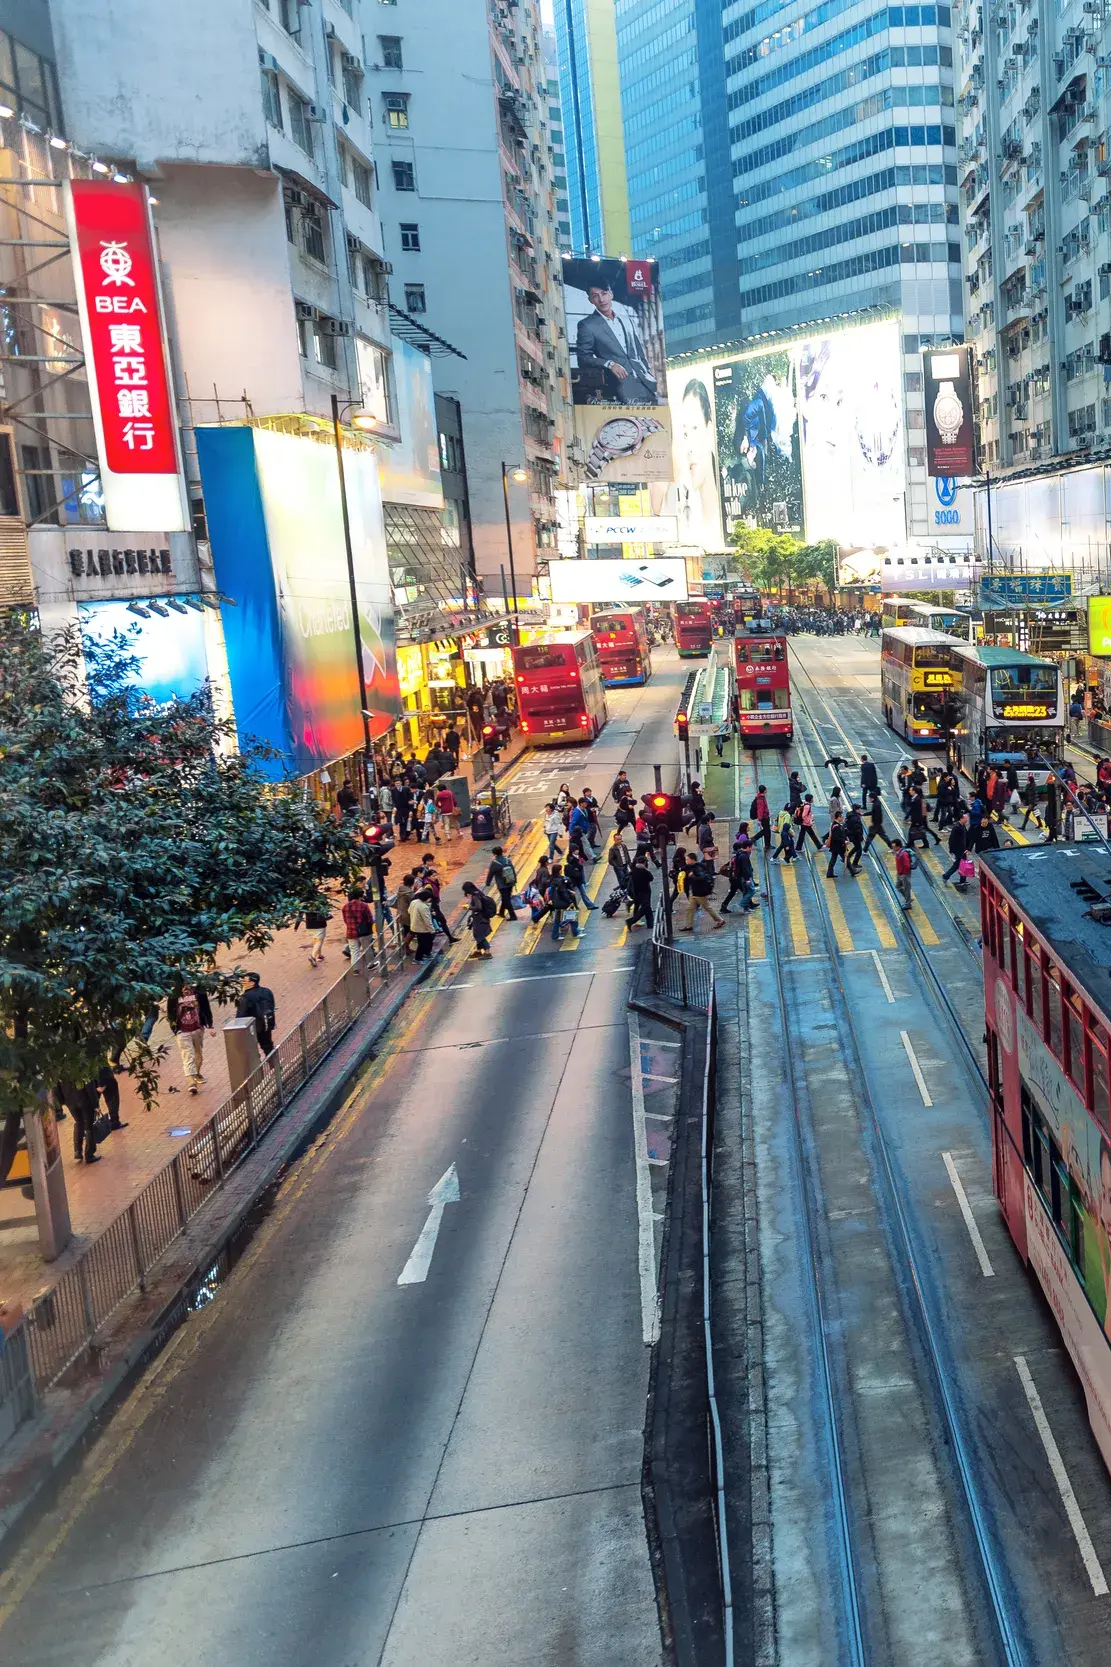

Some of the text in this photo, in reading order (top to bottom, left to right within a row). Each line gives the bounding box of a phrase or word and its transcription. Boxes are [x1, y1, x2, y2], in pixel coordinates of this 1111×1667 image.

[95, 296, 148, 314] BEA
[108, 323, 156, 451] 東亞銀行
[935, 510, 960, 525] SOGO
